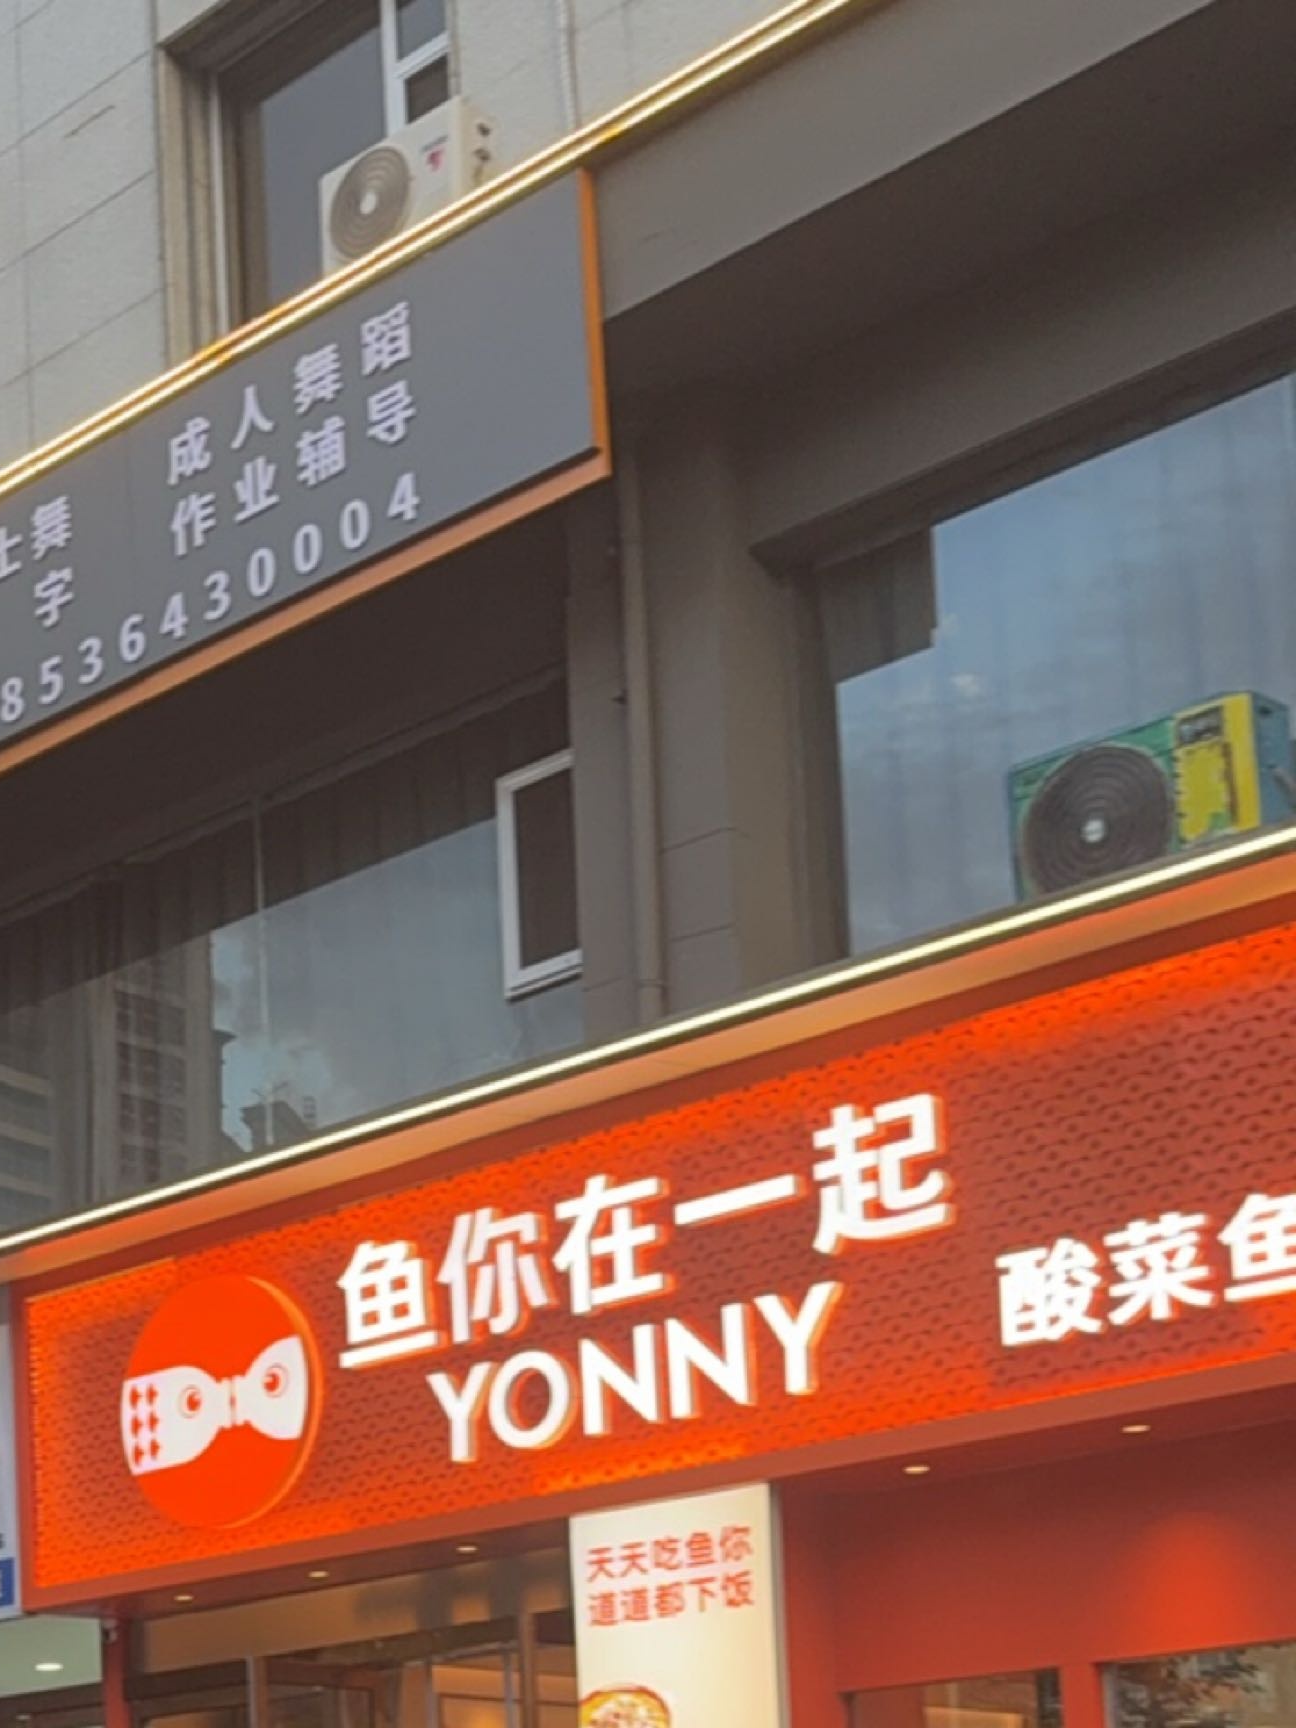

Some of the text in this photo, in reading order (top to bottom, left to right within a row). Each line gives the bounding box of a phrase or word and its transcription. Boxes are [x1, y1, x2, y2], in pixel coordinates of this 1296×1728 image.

[166, 302, 412, 486] 成人舞蹈
[170, 381, 417, 557] 作业辅导
[337, 1092, 951, 1369] 鱼你在一起
[996, 1192, 1296, 1348] 酸菜鱼
[427, 1281, 842, 1463] YONNY
[586, 1525, 753, 1583] 天天吃鱼你
[588, 1569, 755, 1627] 道道都下饭
